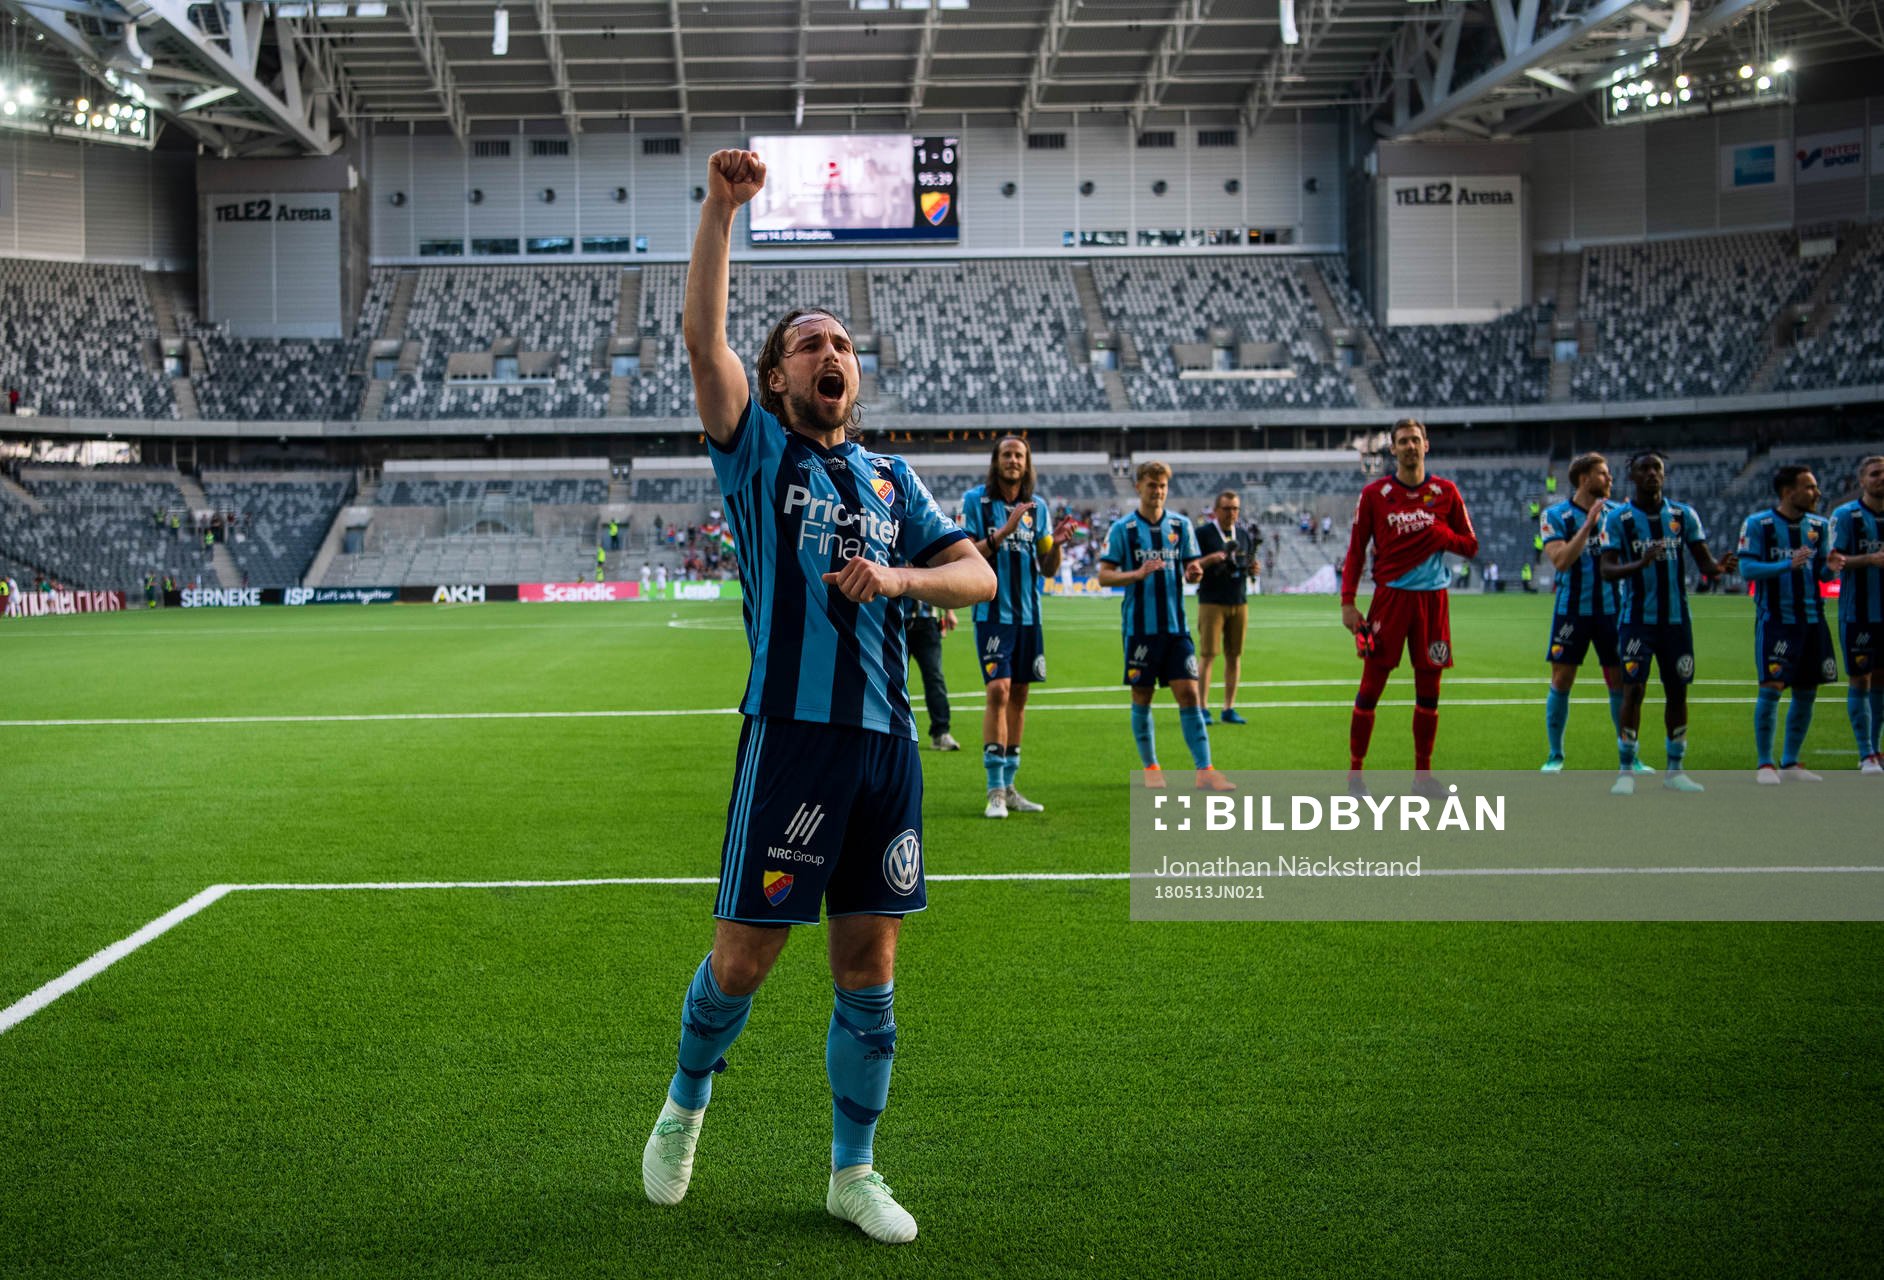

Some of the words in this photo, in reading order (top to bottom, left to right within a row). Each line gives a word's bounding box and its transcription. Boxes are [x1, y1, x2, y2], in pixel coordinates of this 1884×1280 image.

[918, 149, 927, 165] 1
[942, 147, 954, 164] 0
[1824, 144, 1860, 156] INTER
[1823, 153, 1860, 168] SPORT
[1395, 182, 1452, 205] TELE2
[1457, 187, 1513, 206] Arena
[215, 199, 271, 222] TELE2
[276, 204, 331, 221] Arena
[784, 484, 900, 549] Prioritet
[181, 587, 260, 607] SERNEKE
[284, 587, 314, 605] ISP
[543, 582, 616, 602] Scandic
[767, 846, 792, 860] NRC
[793, 850, 825, 866] Group
